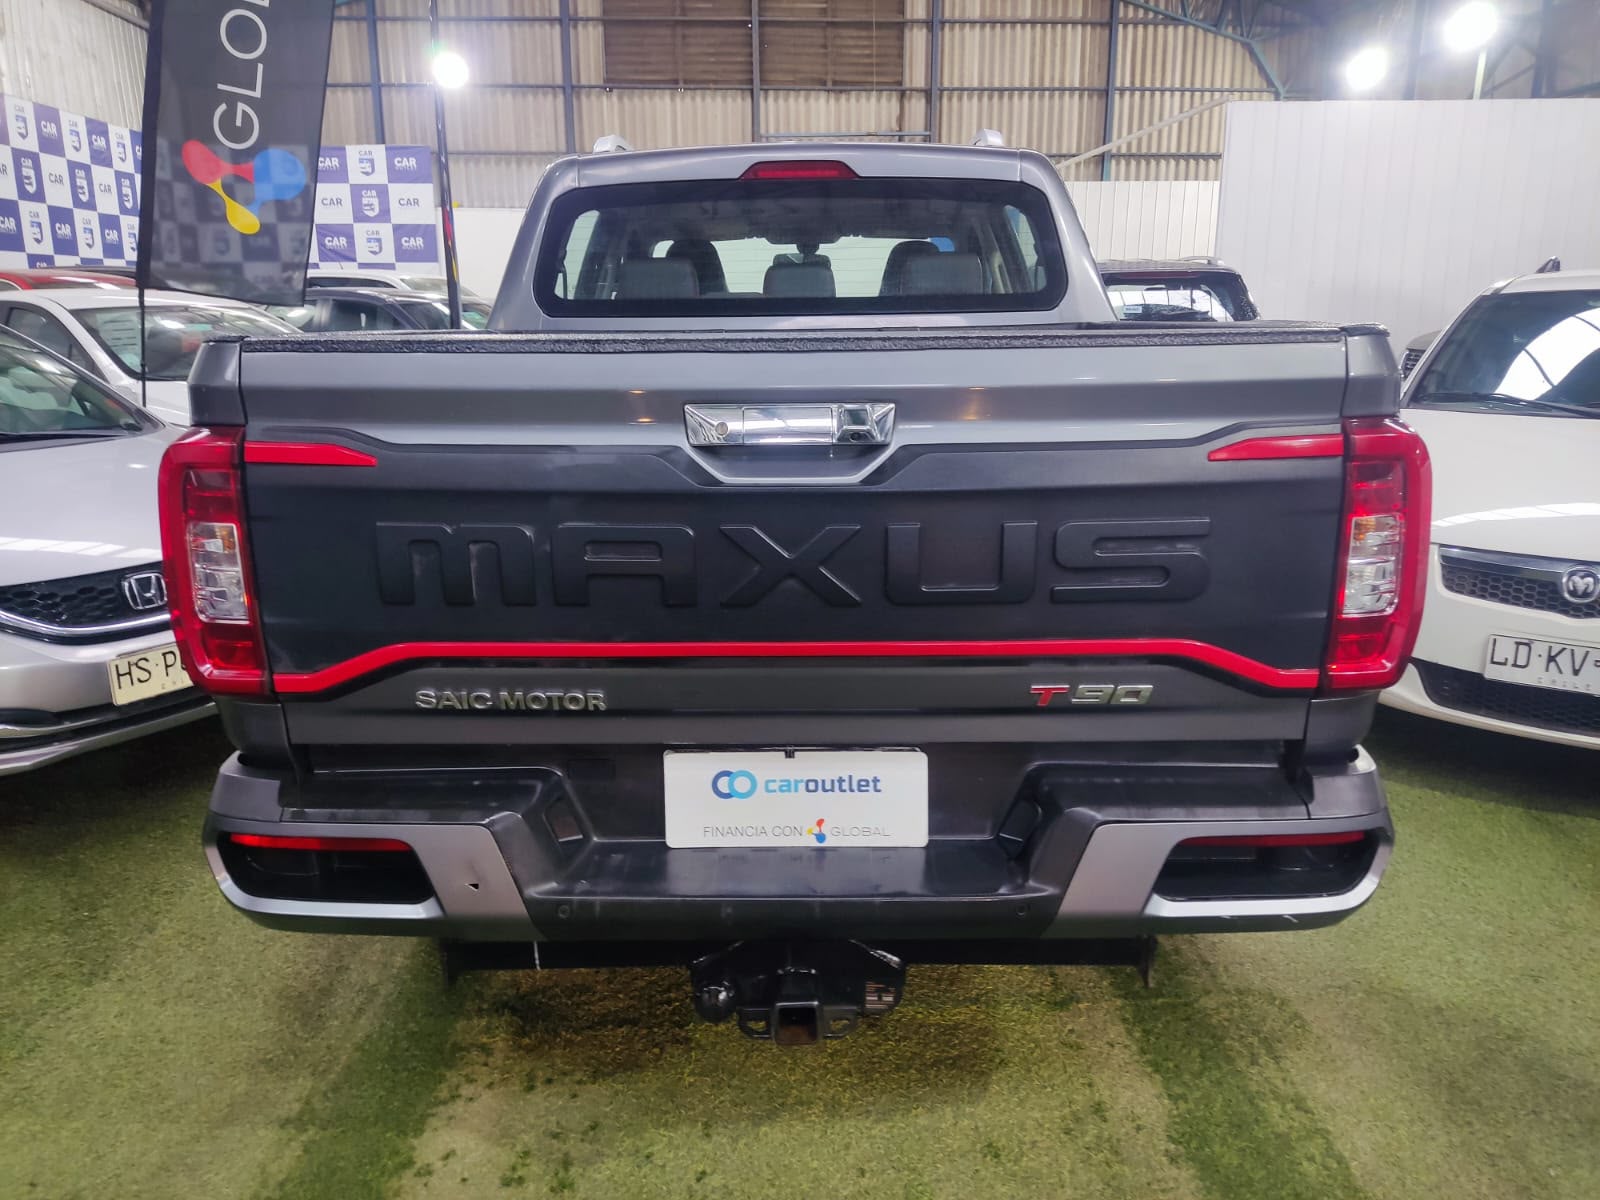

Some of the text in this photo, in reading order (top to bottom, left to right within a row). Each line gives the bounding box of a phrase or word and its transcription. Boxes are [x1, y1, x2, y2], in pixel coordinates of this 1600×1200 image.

[213, 0, 270, 150] GLO
[41, 120, 57, 136] CAR
[92, 134, 106, 148] CAR
[318, 157, 340, 169] CAR
[394, 157, 417, 169] CAR
[48, 172, 64, 185] CAR
[98, 183, 112, 194] CAR
[321, 197, 343, 207] CAR
[398, 197, 420, 207] CAR
[0, 216, 16, 231] CAR
[55, 222, 72, 236] CAR
[105, 229, 118, 241] CAR
[324, 236, 347, 248] CAR
[401, 236, 424, 248] CAR
[375, 518, 1211, 607] MAXUS
[415, 690, 607, 711] SAIC MOTOR
[1029, 685, 1153, 706] T90
[764, 774, 882, 793] caroutlet
[703, 825, 891, 838] FINANCIA CON GLOBAL
